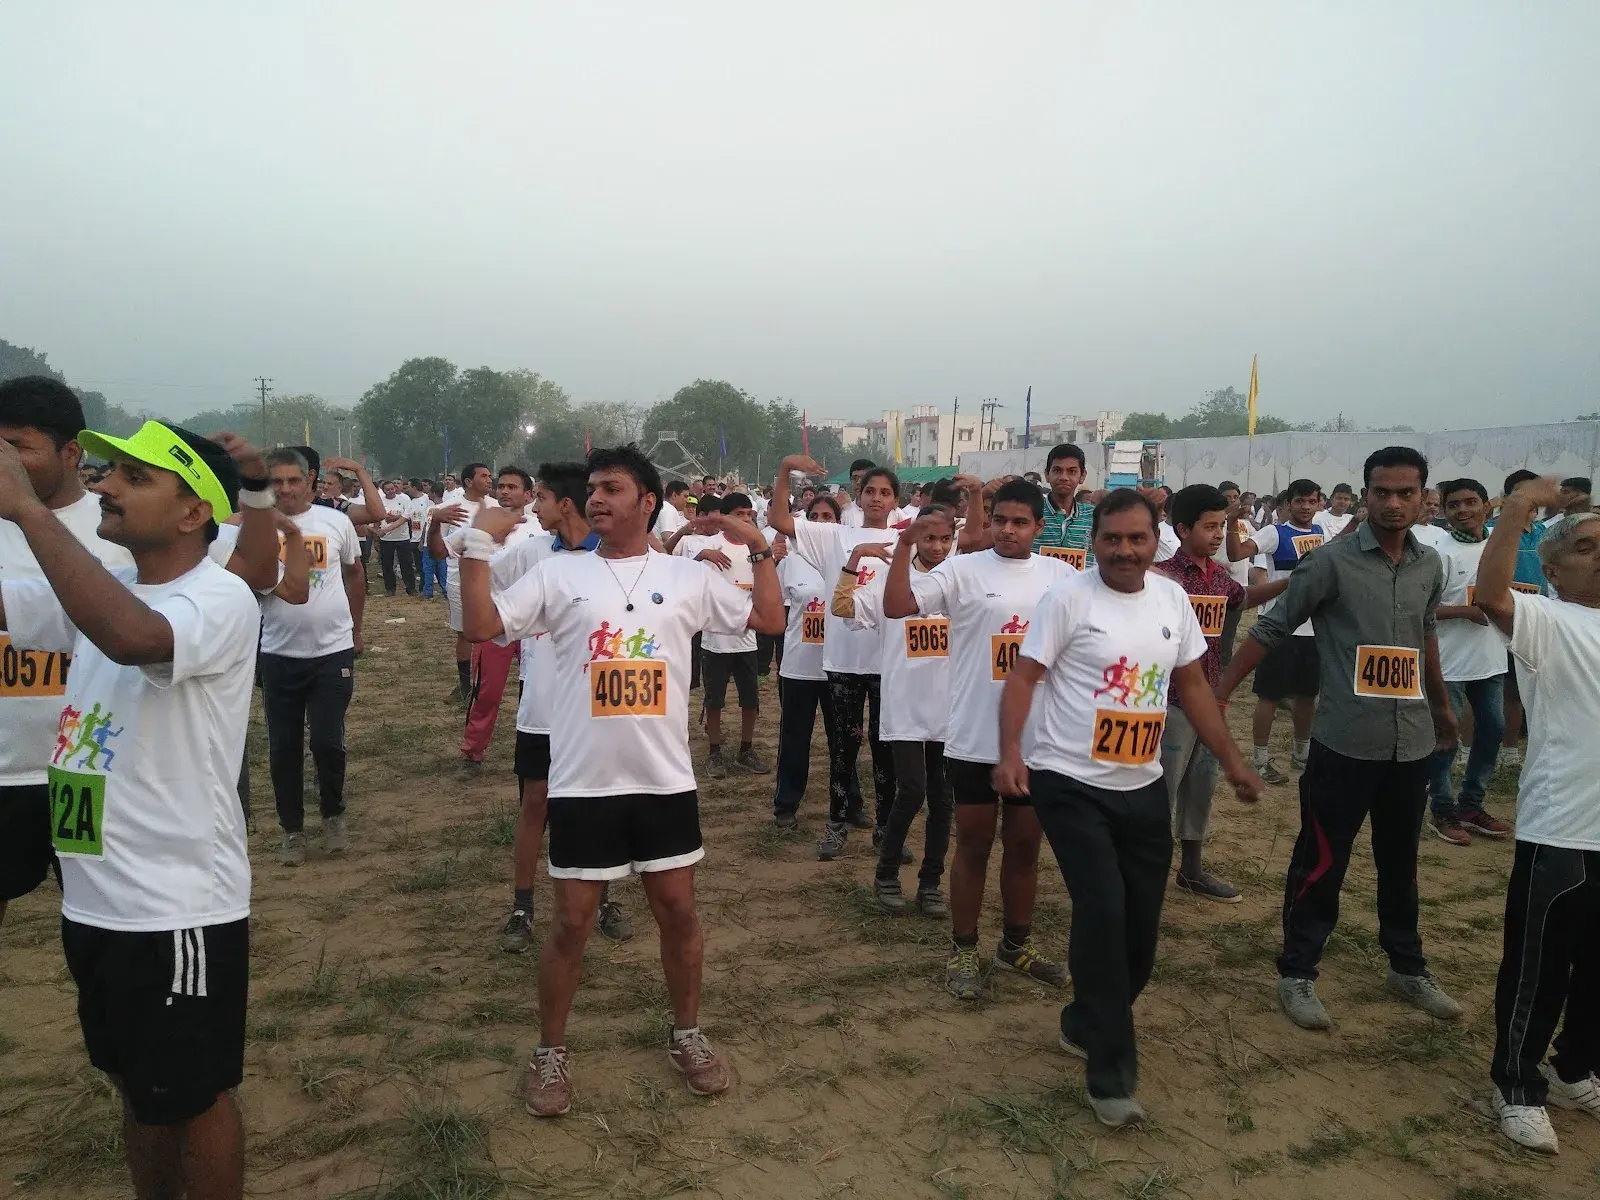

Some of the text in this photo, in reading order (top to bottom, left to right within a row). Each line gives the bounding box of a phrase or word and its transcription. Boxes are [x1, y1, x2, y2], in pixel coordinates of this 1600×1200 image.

[1191, 602, 1224, 628] 061F
[909, 624, 948, 652] 5065
[0, 644, 71, 687] 057F
[1362, 655, 1415, 689] 4080F
[595, 669, 662, 707] 4053F
[1096, 718, 1161, 756] 2717D
